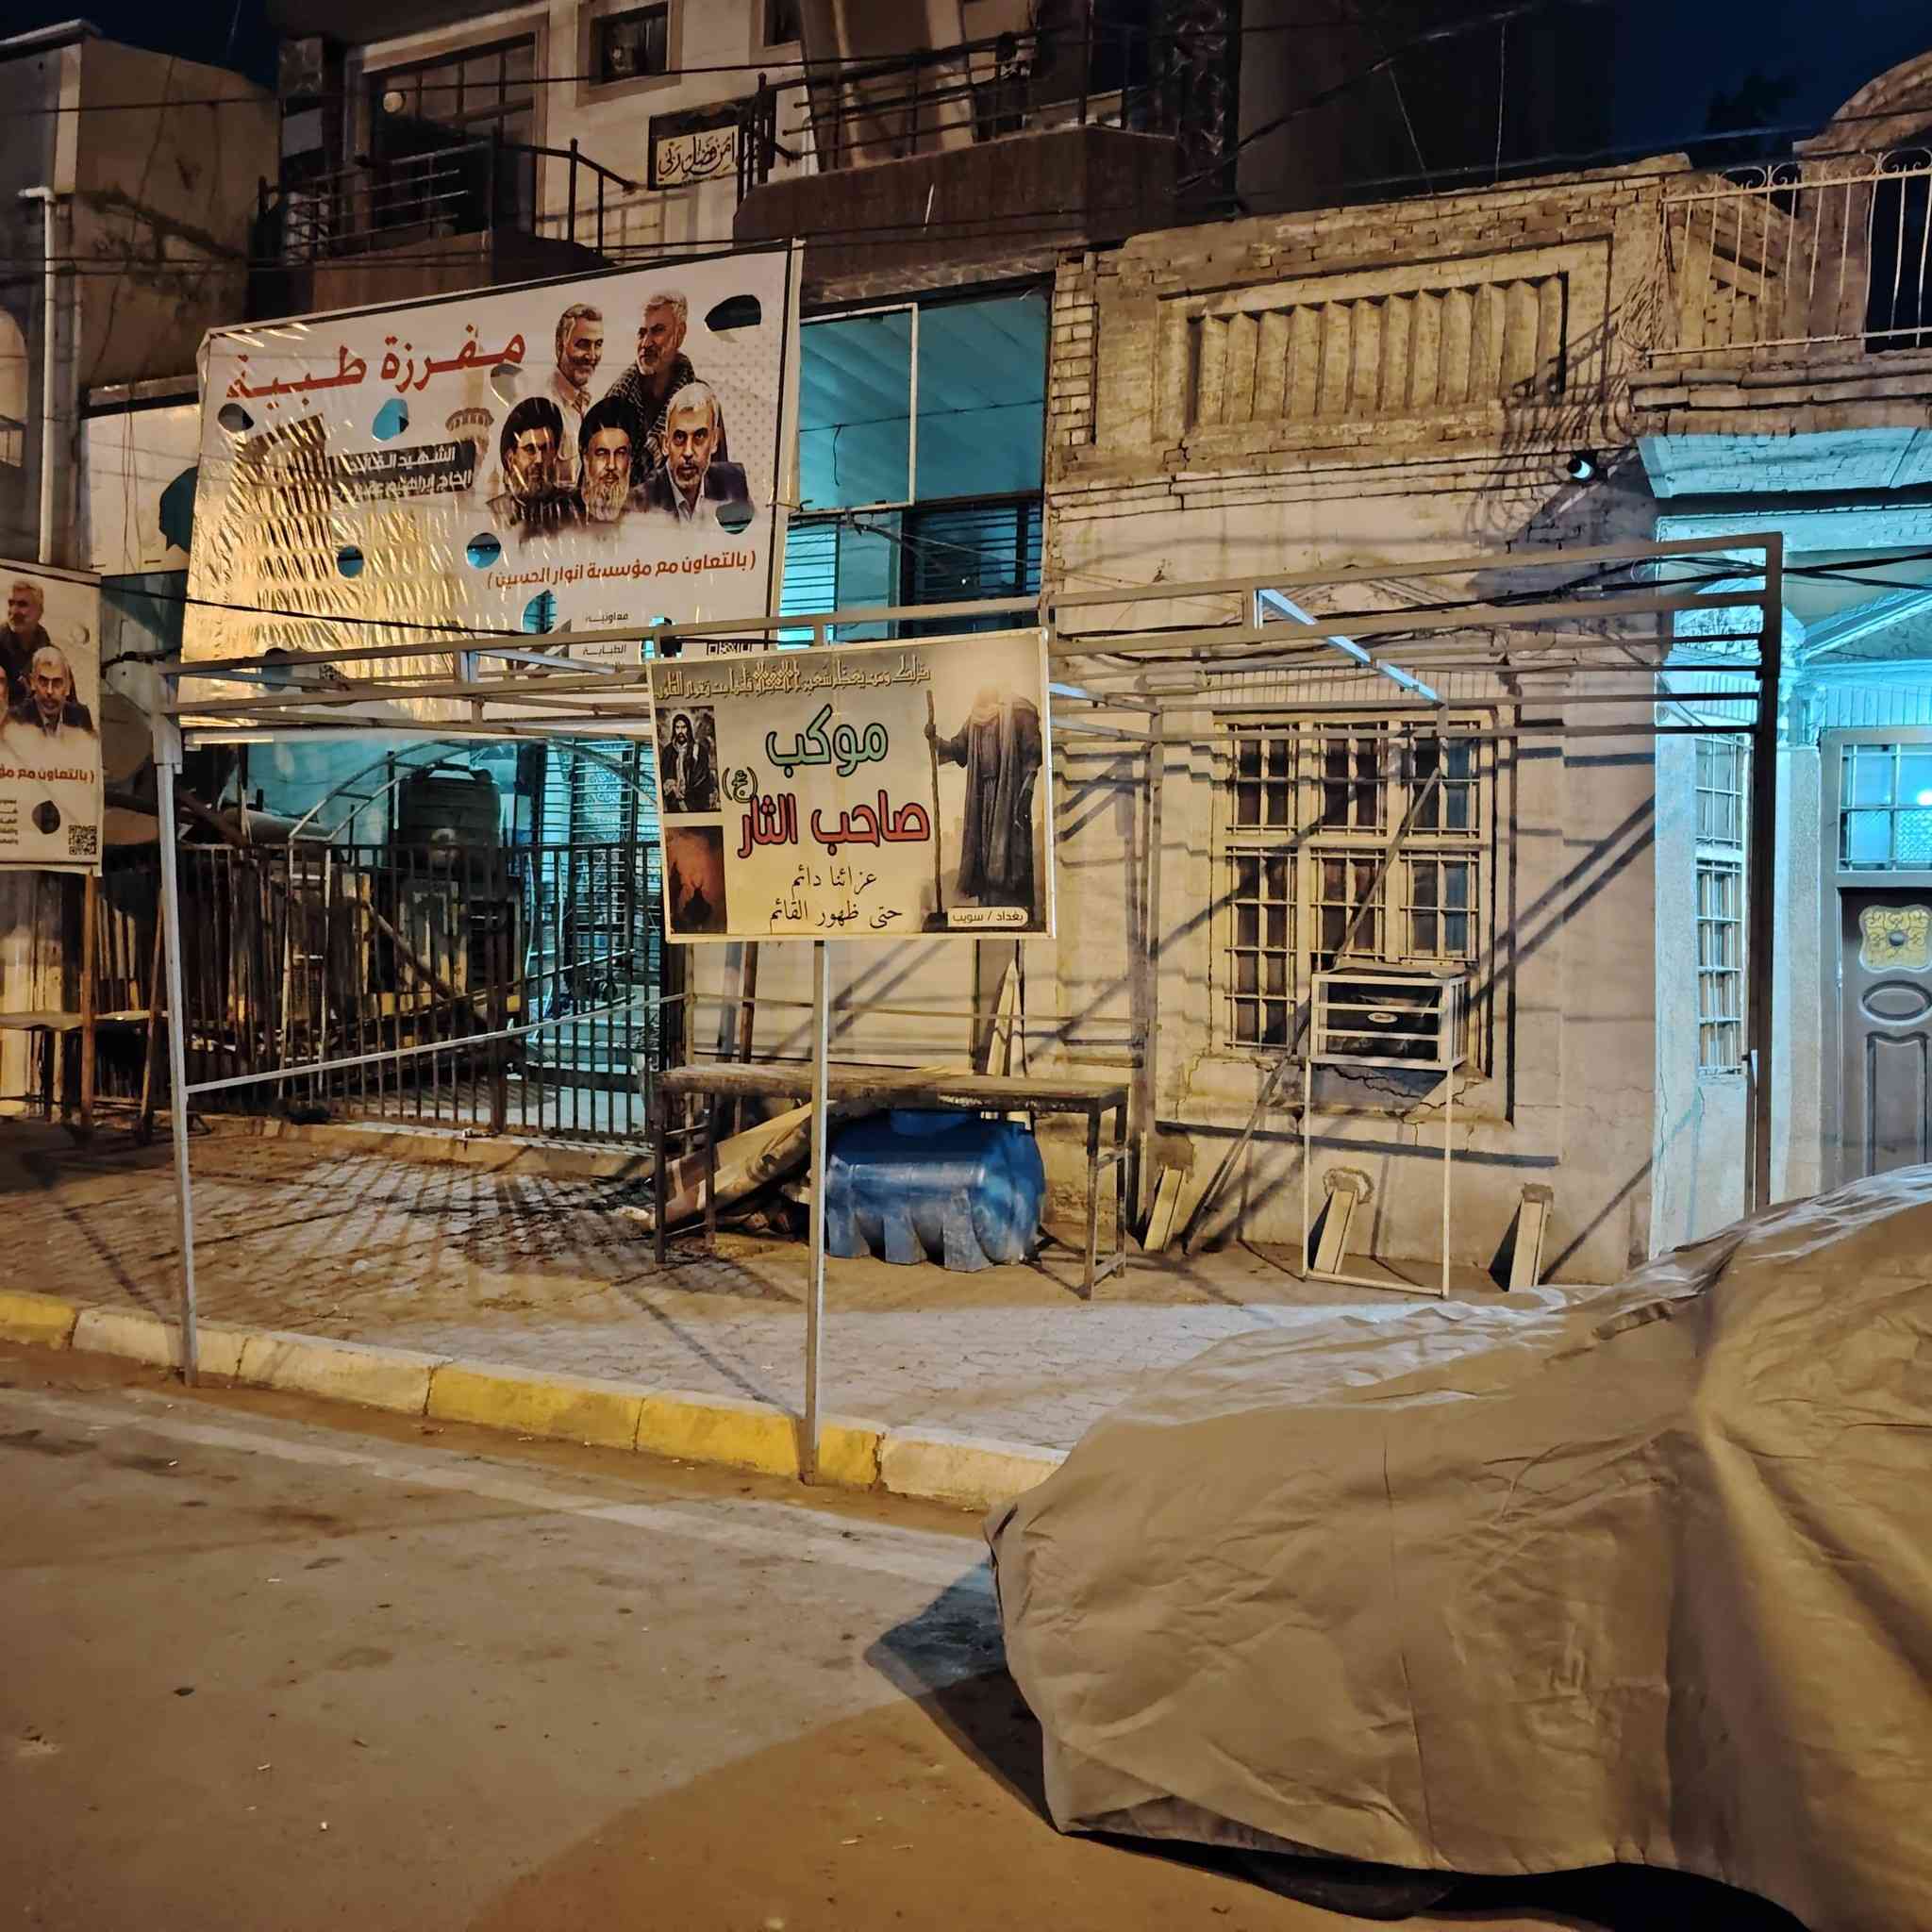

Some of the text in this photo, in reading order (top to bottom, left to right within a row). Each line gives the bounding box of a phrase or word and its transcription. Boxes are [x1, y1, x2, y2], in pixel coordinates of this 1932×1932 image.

[225, 325, 526, 410] مفرزة طبية
[397, 444, 457, 470] الشهيد
[436, 469, 473, 491] الحاج
[552, 564, 584, 586] انوار
[587, 558, 652, 579] مؤسسة
[655, 560, 679, 577] مع
[766, 704, 889, 778] موكب
[810, 790, 931, 857] صاحب
[791, 863, 877, 900] عزائنا دائم
[769, 897, 903, 935] حتى ظهور القائم
[996, 909, 1024, 923] بغداد
